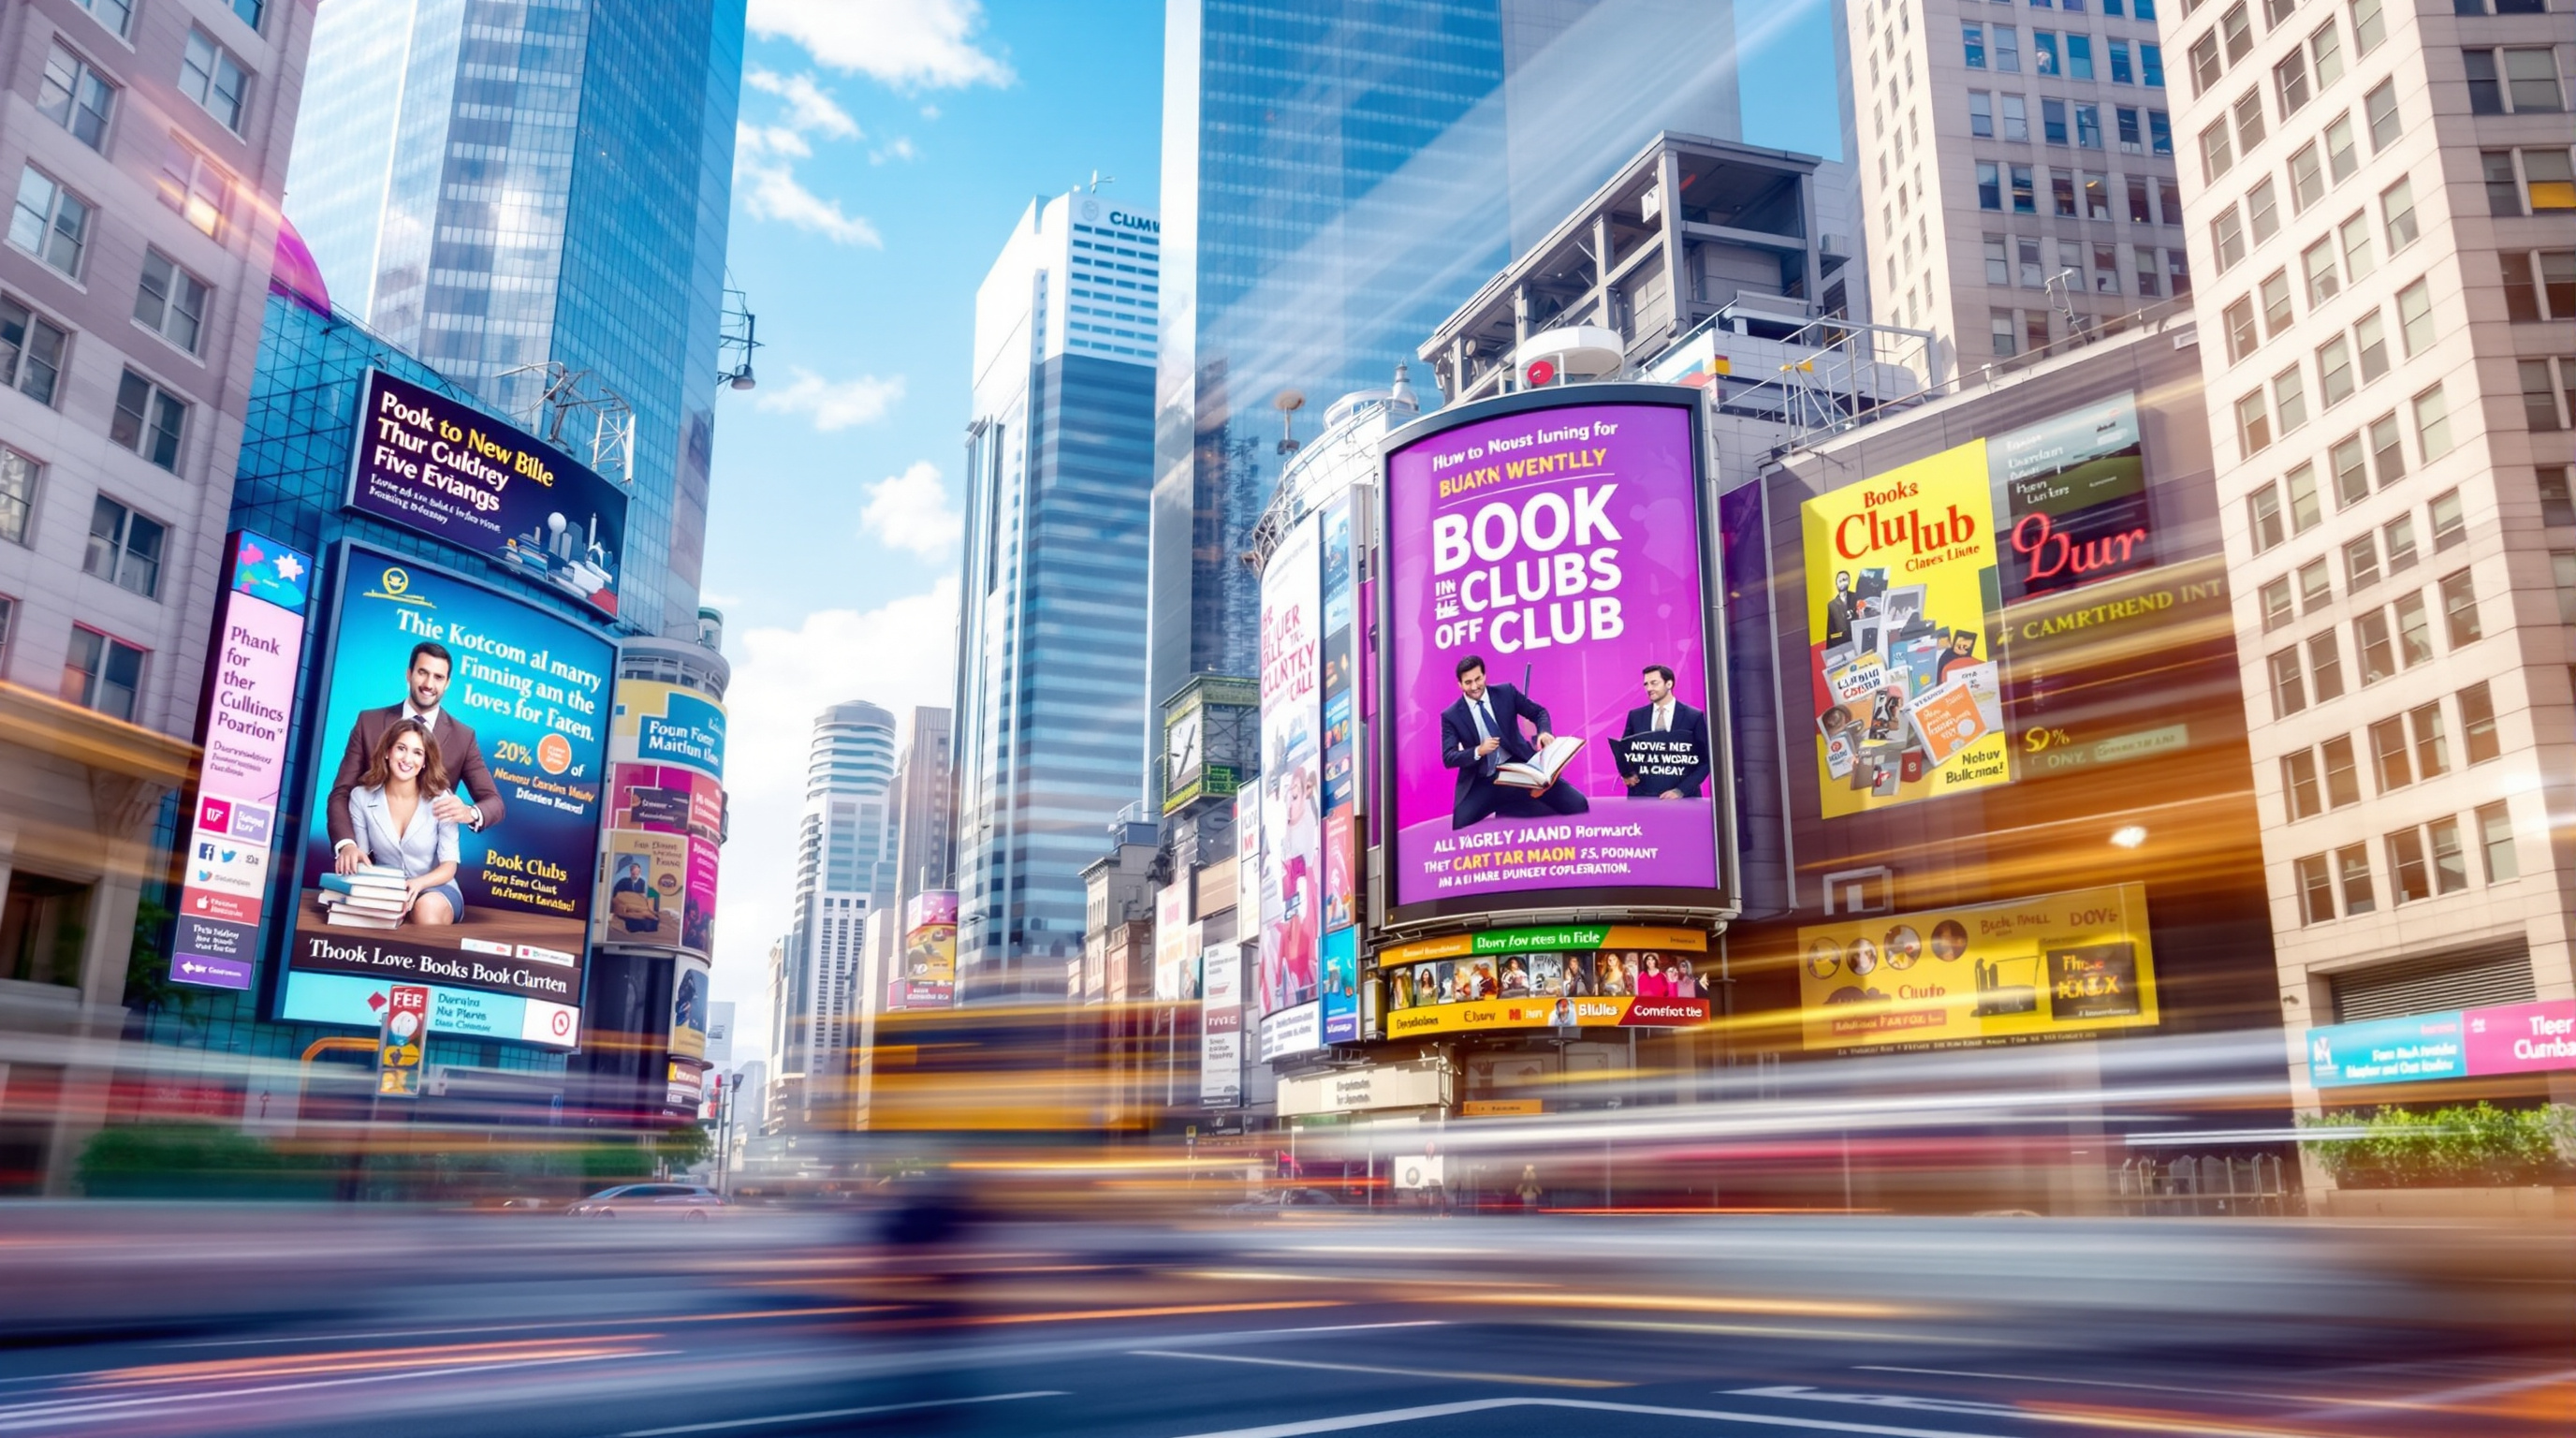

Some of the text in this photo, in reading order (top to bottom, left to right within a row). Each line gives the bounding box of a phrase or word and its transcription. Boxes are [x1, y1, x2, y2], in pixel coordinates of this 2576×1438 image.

[381, 391, 433, 433] Pook
[439, 419, 463, 443] to
[468, 429, 512, 464] New
[1468, 448, 1483, 461] to
[1593, 420, 1618, 436] for
[377, 418, 509, 492] Thur Culdrey
[1505, 448, 1607, 479] WENTLLY
[373, 445, 418, 480] Five
[422, 463, 501, 512] Eviangs
[1863, 481, 1919, 509] Books
[1433, 483, 1623, 576] BOOK
[1460, 547, 1622, 612] CLUBS
[230, 625, 281, 655] Phank
[1435, 596, 1625, 653] OFF CLUB
[227, 648, 251, 668] for
[397, 609, 601, 693] Thie Kotcom al marry
[224, 670, 256, 691] ther
[461, 655, 595, 715] Finning am the
[463, 683, 511, 715] loves
[515, 697, 543, 723] for
[494, 740, 533, 766] 20%
[571, 764, 586, 777] of
[1433, 839, 1456, 854] ALL
[1518, 826, 1571, 844] JAAND
[1453, 852, 1491, 872] CART
[1494, 850, 1524, 866] TAR
[1528, 846, 1575, 863] MAON
[487, 849, 523, 872] Book
[526, 859, 567, 882] Clubs
[309, 937, 369, 963] Thook
[419, 955, 468, 979] Books
[472, 962, 511, 984] Book
